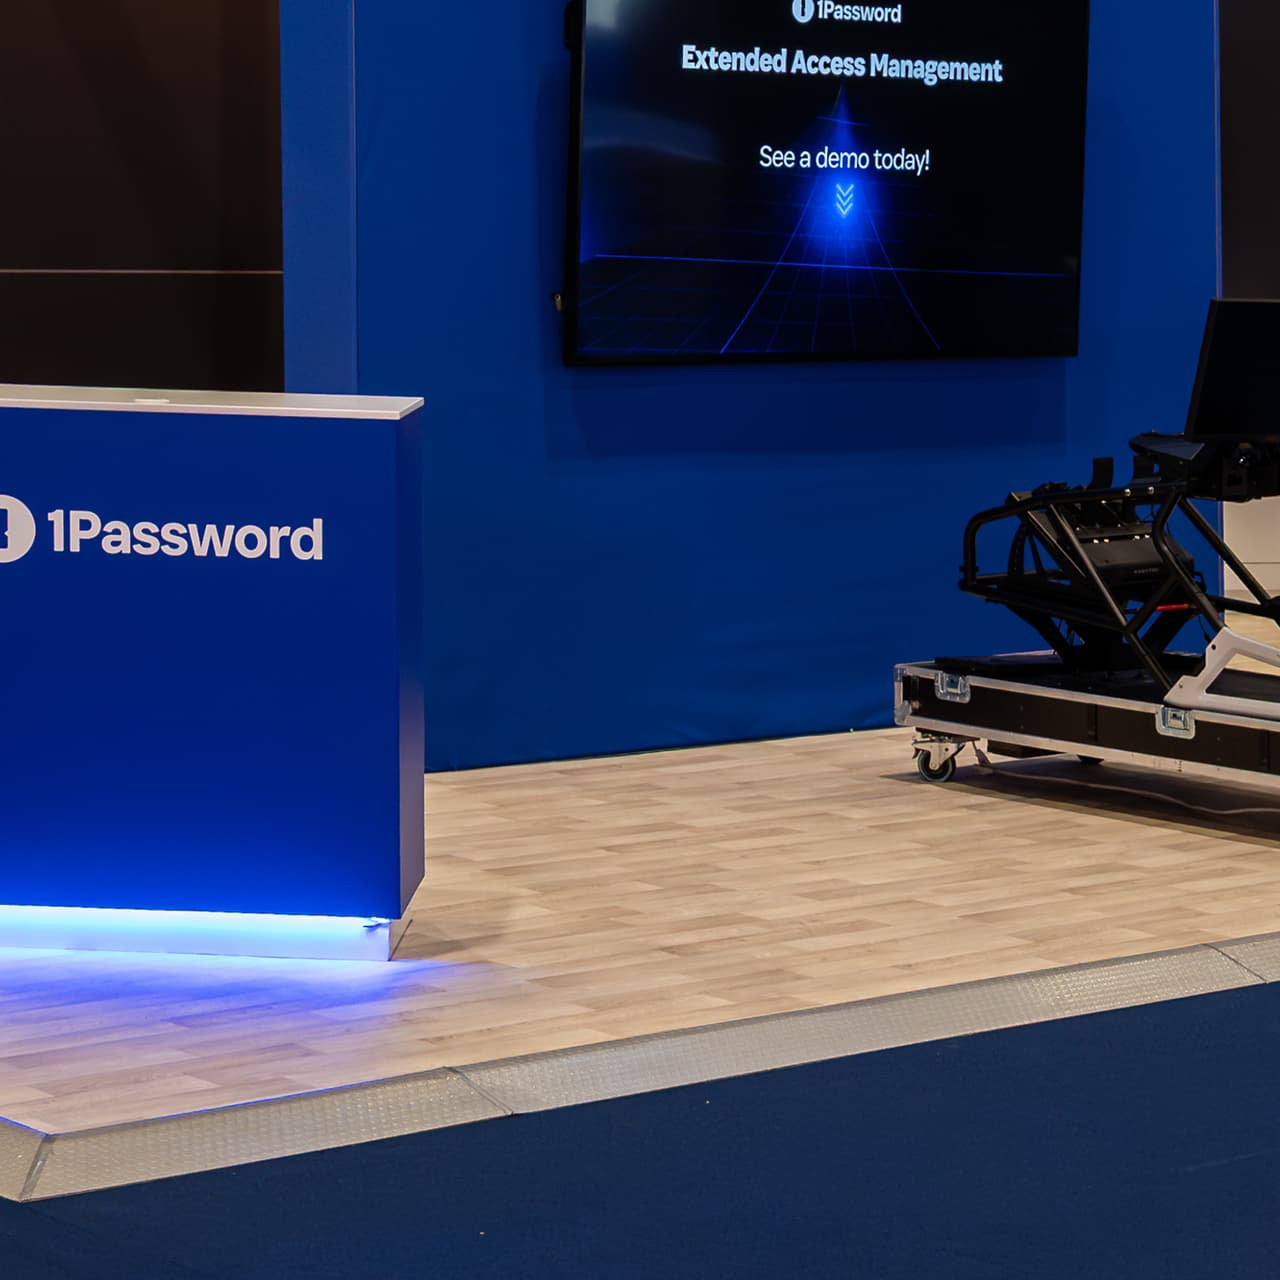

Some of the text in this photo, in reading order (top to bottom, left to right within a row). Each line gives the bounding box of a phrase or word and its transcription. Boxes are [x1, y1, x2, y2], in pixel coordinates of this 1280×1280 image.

[816, 0, 902, 23] 1Password
[682, 45, 1004, 85] Extended Access Management
[759, 145, 931, 176] See a demo today!
[47, 509, 323, 560] 1Password
